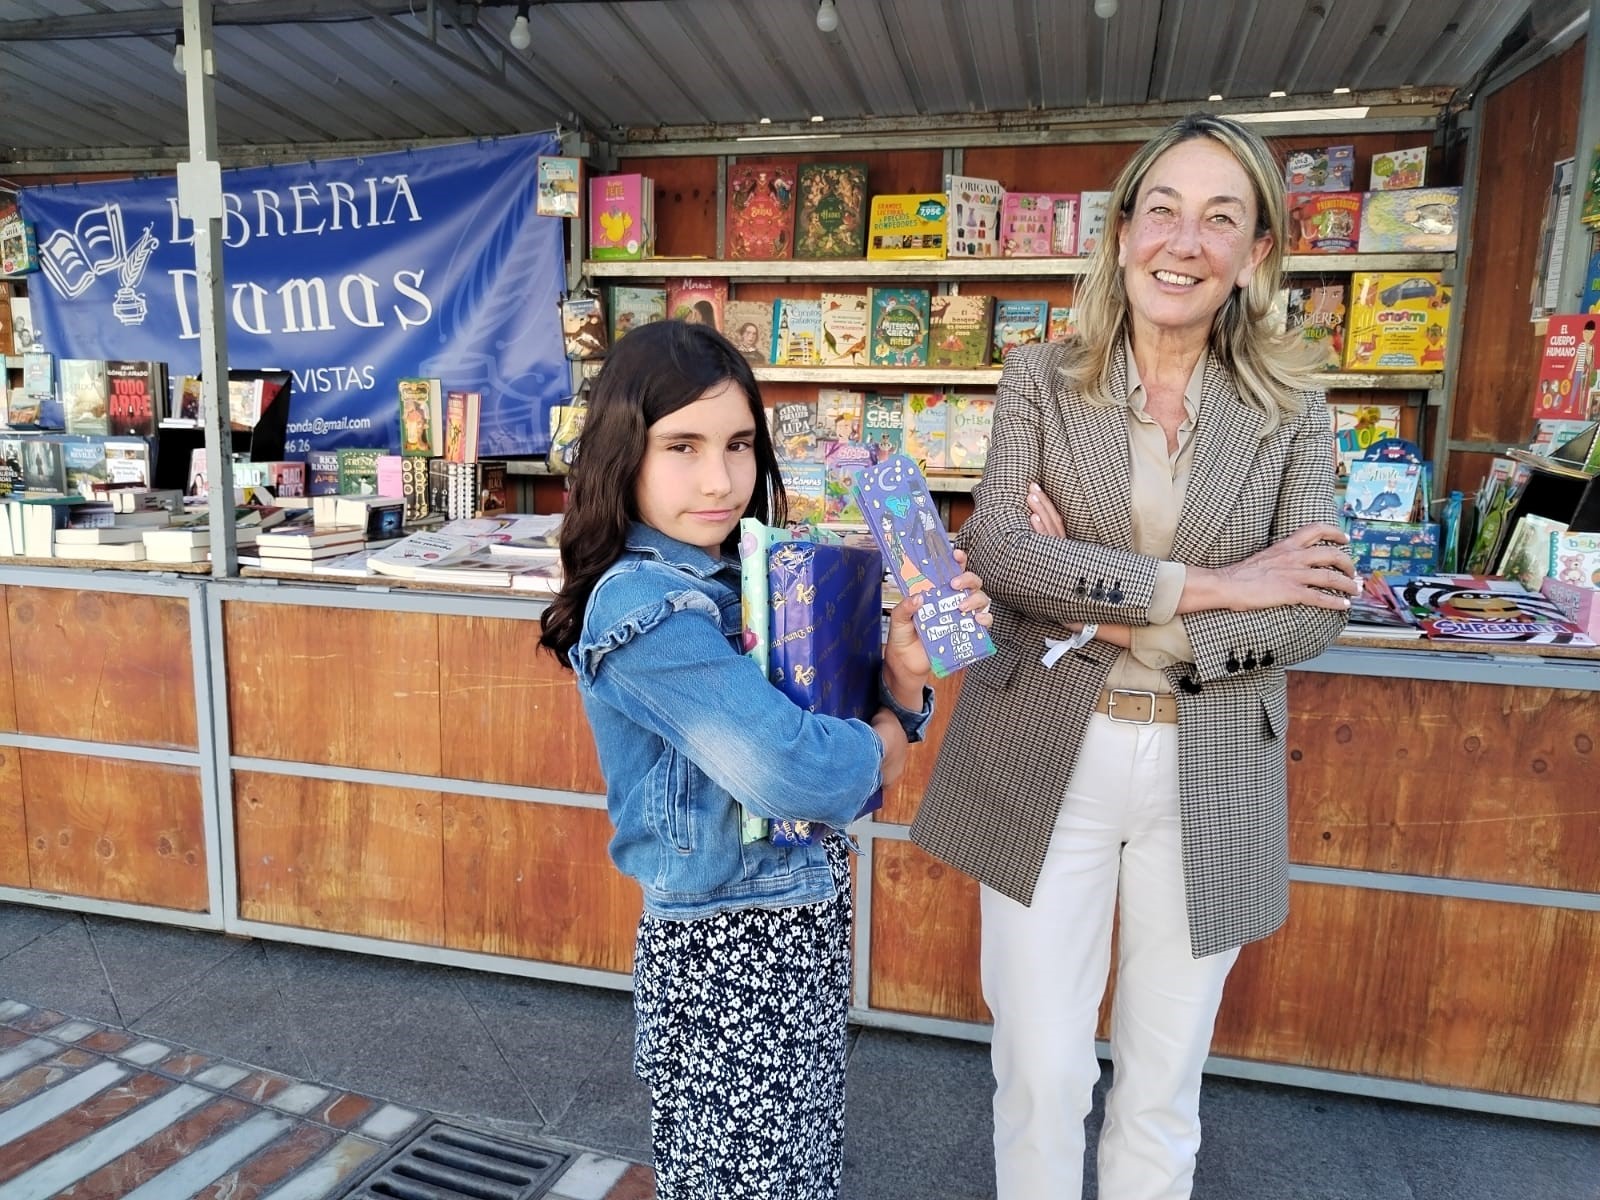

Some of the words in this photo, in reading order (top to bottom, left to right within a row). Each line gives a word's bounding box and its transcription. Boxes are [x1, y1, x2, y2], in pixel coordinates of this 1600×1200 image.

[960, 181, 1000, 194] ORIGAMI
[920, 207, 941, 216] 7,95€
[874, 219, 918, 230] ROMPEDORES
[1560, 324, 1568, 334] EL
[1550, 335, 1576, 347] CUERPO
[1546, 346, 1576, 357] HUMANO
[290, 365, 375, 393] VISTAS
[113, 379, 145, 395] TODO
[109, 395, 153, 417] ARDE
[866, 410, 904, 422] CRE
[955, 414, 991, 427] Origa
[286, 416, 371, 435] ronda@gmail.com
[782, 421, 810, 435] LUPA
[298, 439, 311, 452] 26
[311, 462, 339, 472] RIORDA
[344, 457, 378, 466] TRENZ
[282, 468, 301, 484] BAD
